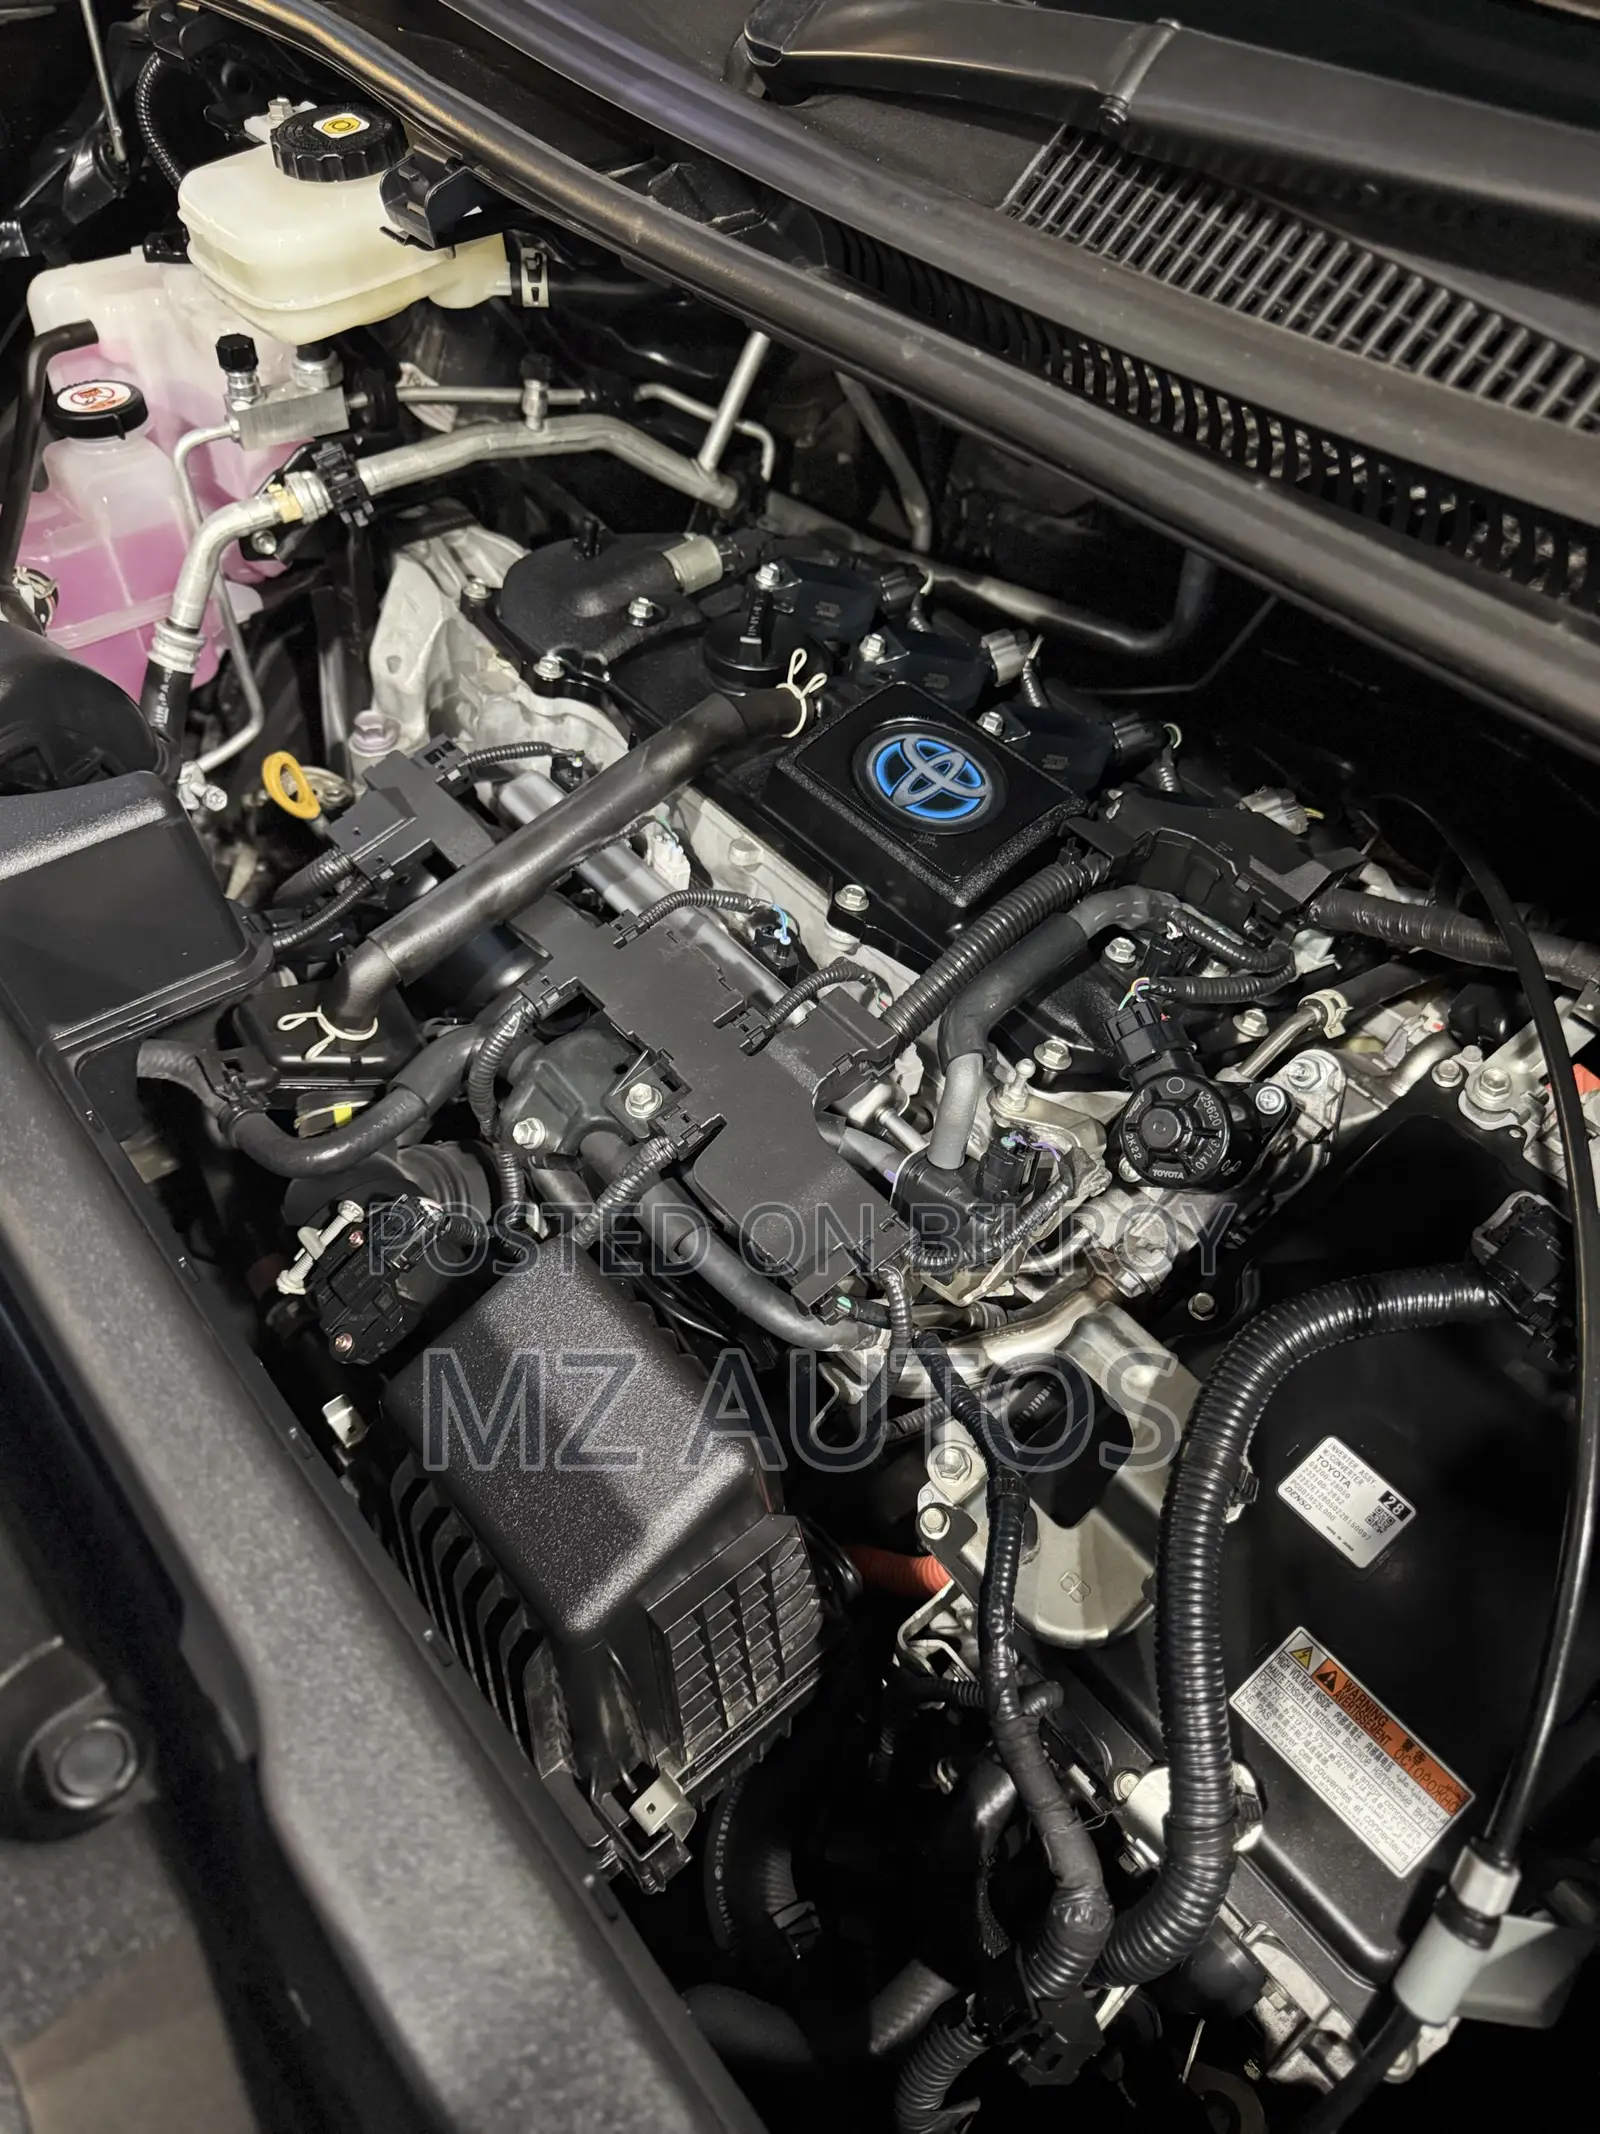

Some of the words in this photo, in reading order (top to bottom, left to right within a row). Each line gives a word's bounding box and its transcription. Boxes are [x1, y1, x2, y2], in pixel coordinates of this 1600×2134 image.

[1125, 1133, 1143, 1161] 2K22
[1152, 1169, 1185, 1180] TOYOTA
[1315, 1454, 1352, 1489] TOYOTA
[1321, 1447, 1364, 1487] W/CONVERTER
[1327, 1441, 1359, 1470] INVERTER
[1283, 1484, 1312, 1512] DENSO
[1382, 1494, 1405, 1516] 28
[1266, 1662, 1287, 1684] HAUTE
[1282, 1679, 1307, 1704] TENSION
[1274, 1652, 1293, 1671] HIGH
[1287, 1666, 1316, 1694] VOLTAGE
[1310, 1688, 1334, 1712] INSIDE
[1331, 1687, 1393, 1748] AVERTISSEMENT
[1340, 1678, 1390, 1728] WARNING
[1241, 1689, 1256, 1704] NE
[1254, 1702, 1272, 1721] PAS
[1297, 1747, 1313, 1764] ces
[1258, 1672, 1272, 1687] DO
[1271, 1685, 1289, 1704] NOT
[1288, 1703, 1314, 1730] remove
[1314, 1729, 1335, 1751] these
[1334, 1750, 1359, 1775] covers
